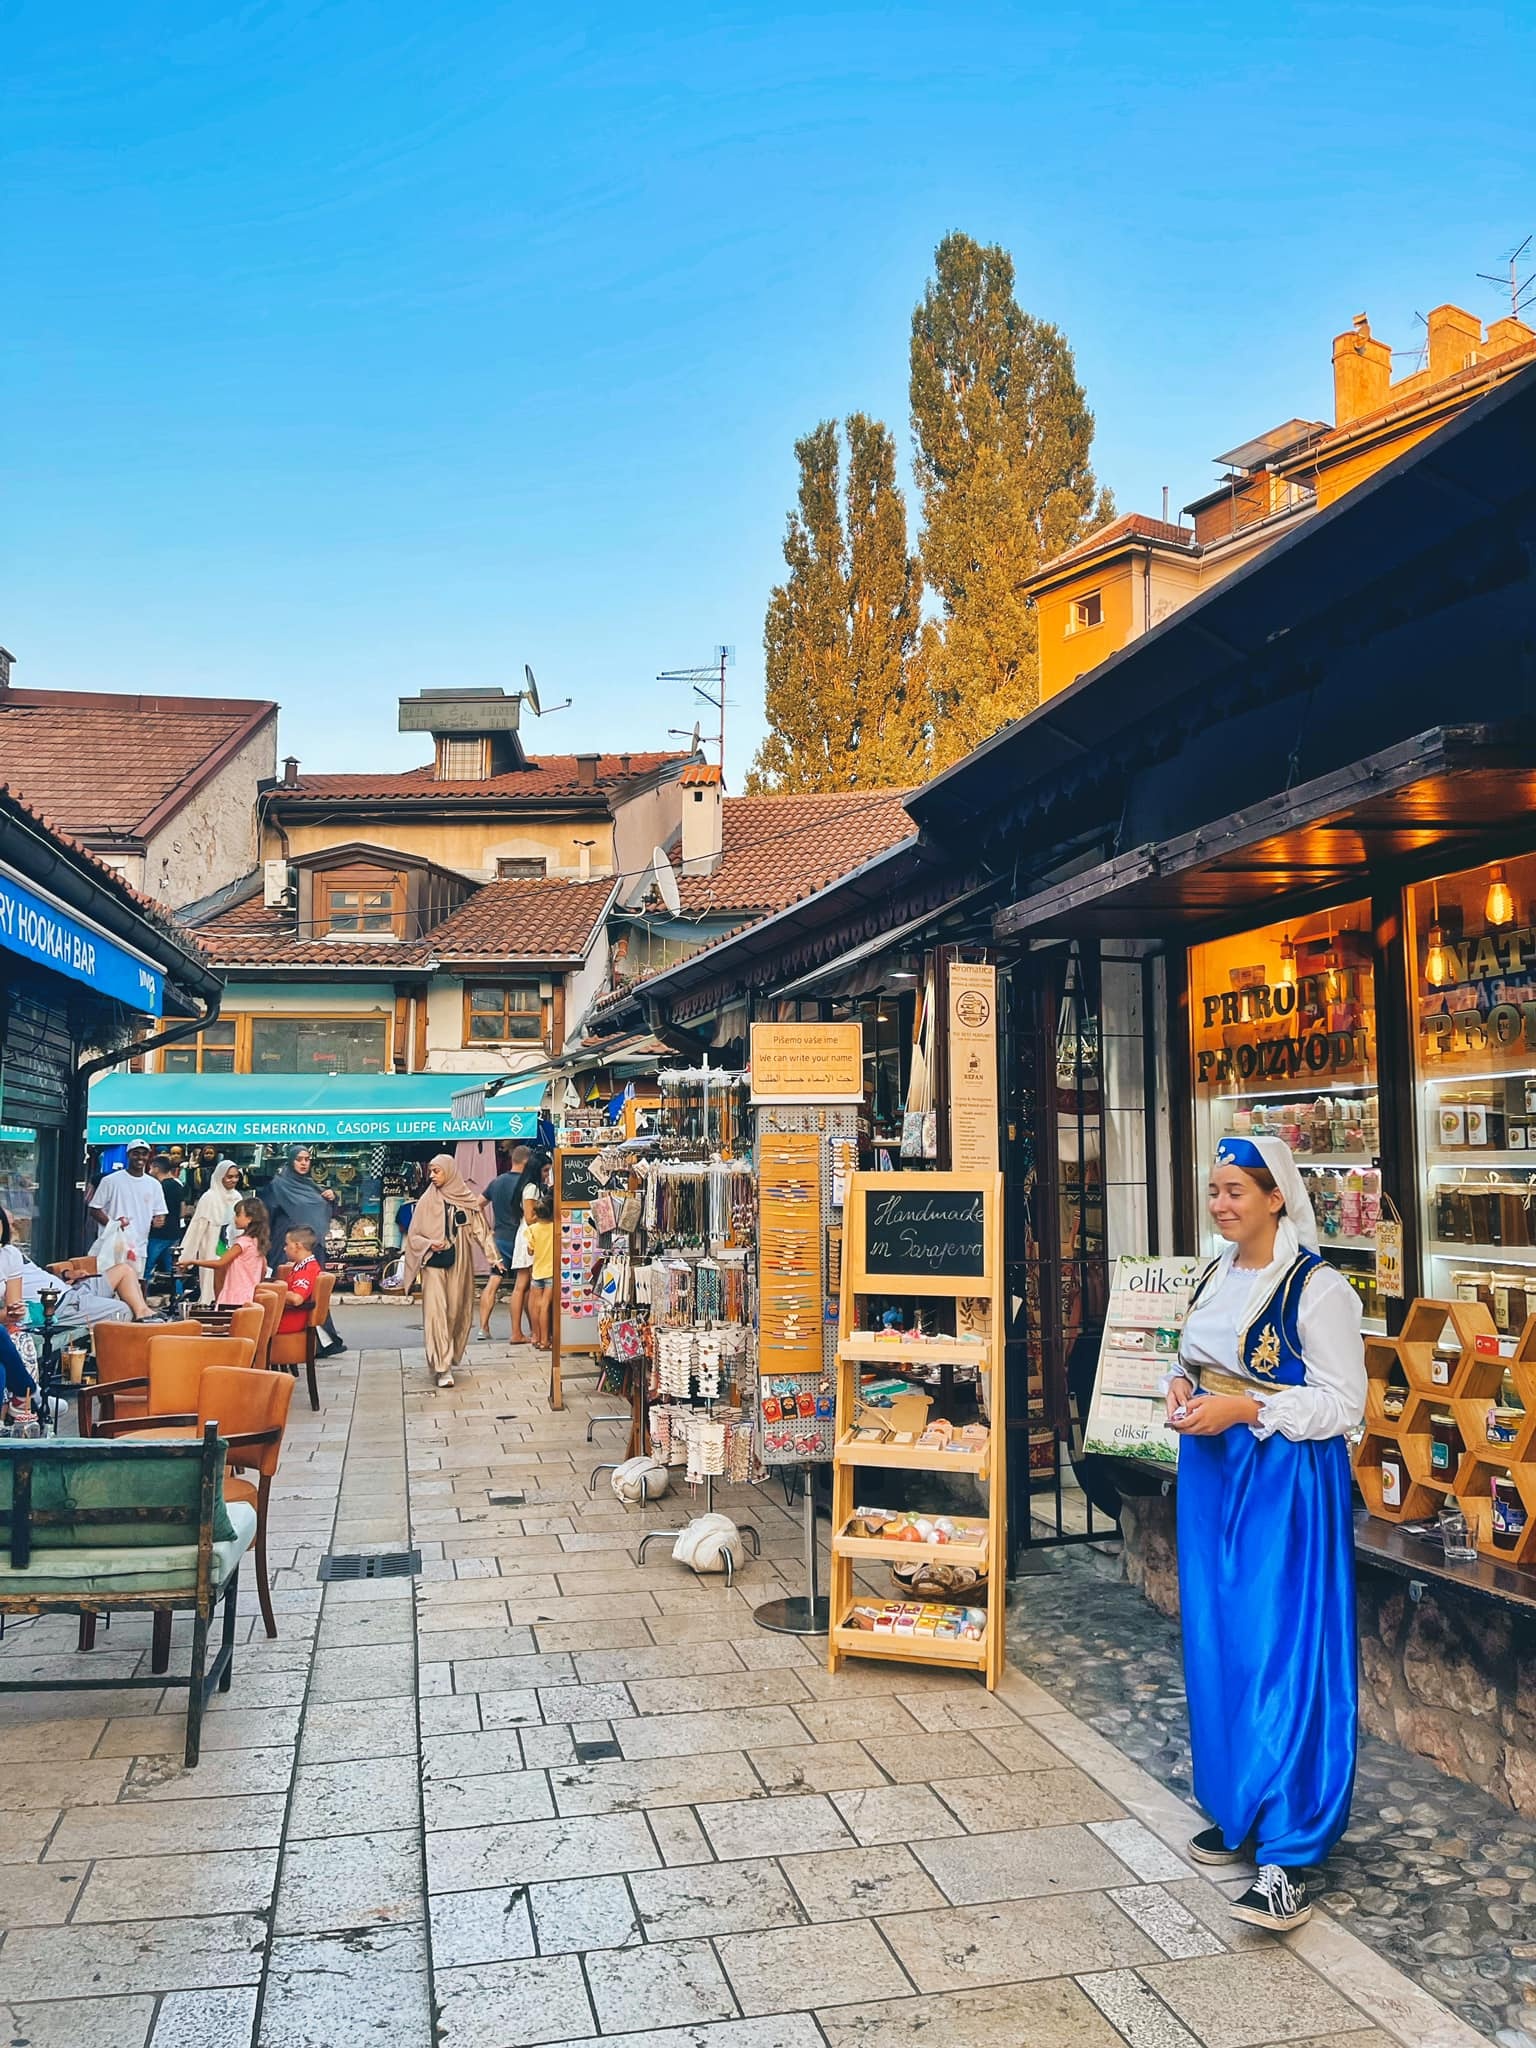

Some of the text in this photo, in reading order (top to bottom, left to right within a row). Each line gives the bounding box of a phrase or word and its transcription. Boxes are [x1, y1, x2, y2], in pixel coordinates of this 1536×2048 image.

[18, 903, 71, 964] HOOKAH
[73, 936, 96, 977] BAR
[1440, 928, 1536, 985] NAT
[773, 1036, 802, 1044] Pišemo
[804, 1036, 822, 1044] vaše
[812, 1056, 830, 1064] your
[1198, 1027, 1369, 1083] PROIZVODI
[99, 1122, 171, 1136] PORODIČNI
[177, 1123, 237, 1135] MAGAZIN
[336, 1121, 390, 1134] ČASOPIS
[396, 1121, 436, 1134] LIJEPE
[442, 1119, 493, 1133] NARAVI!
[874, 1195, 984, 1225] Handmade
[1381, 1234, 1395, 1243] BEES
[899, 1228, 982, 1269] Sarajevo
[1378, 1281, 1400, 1291] WORK
[1114, 1424, 1151, 1440] eliksir
